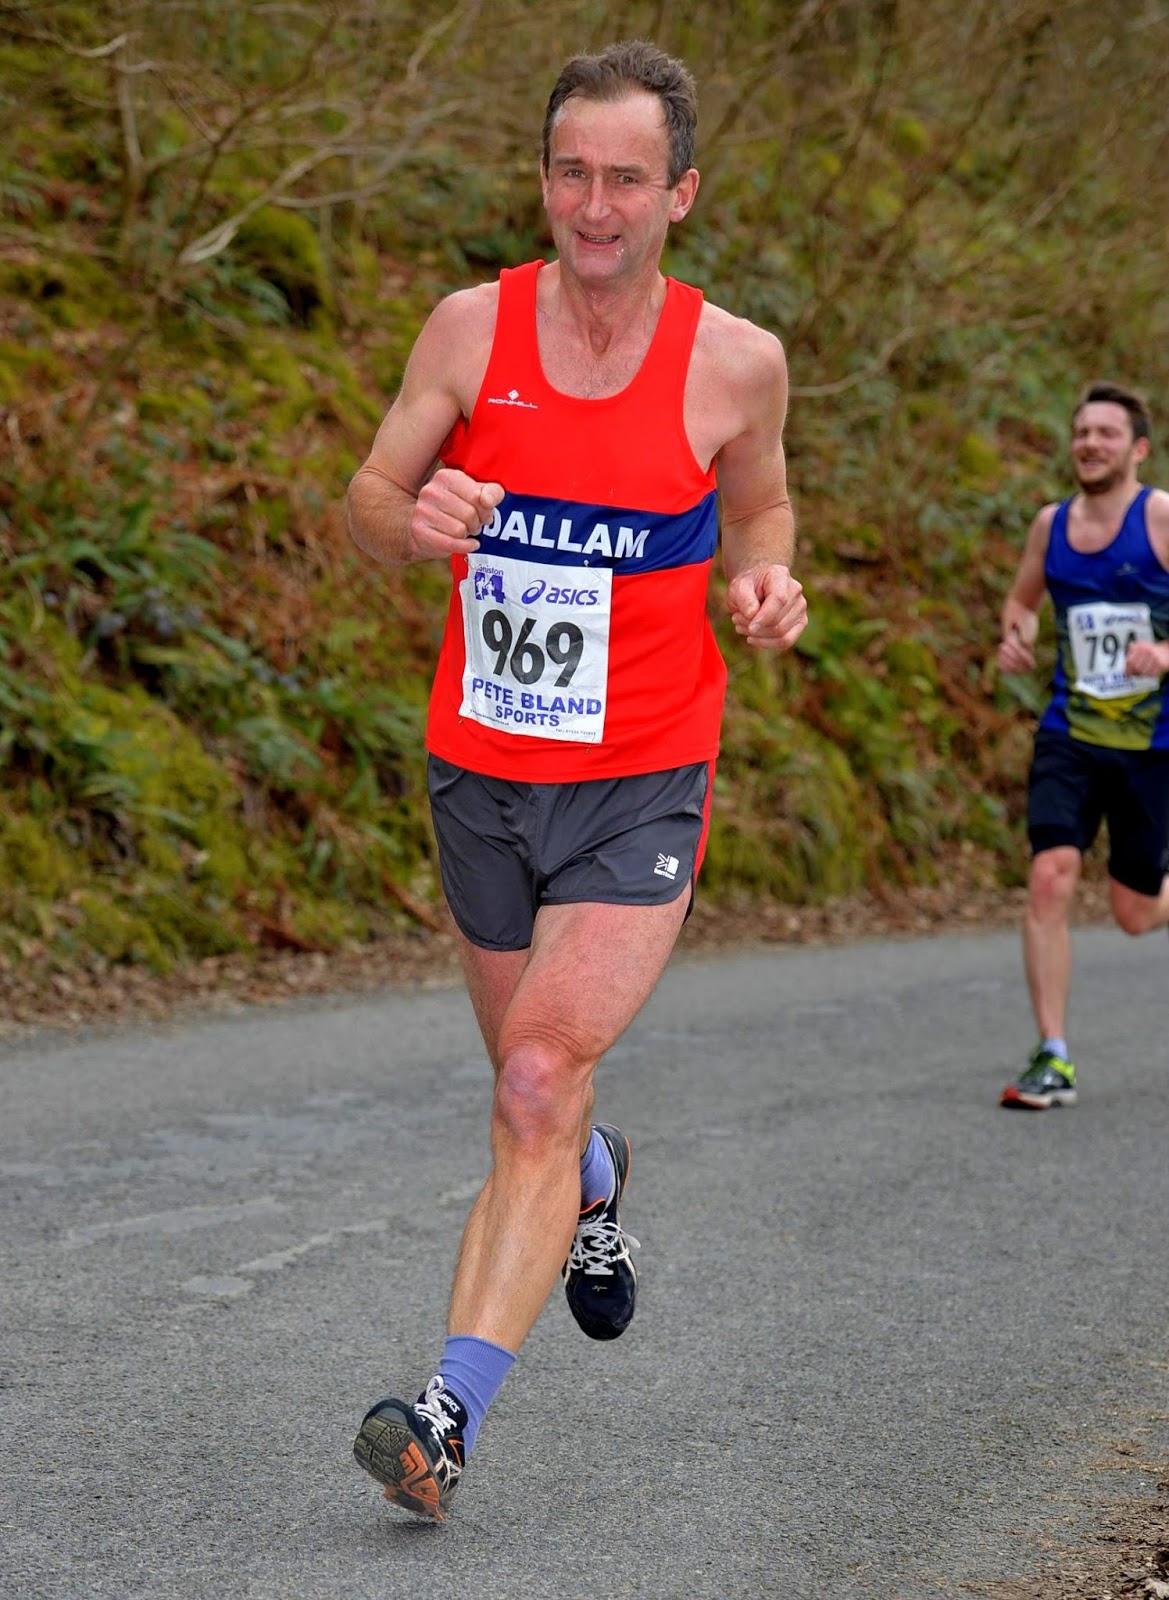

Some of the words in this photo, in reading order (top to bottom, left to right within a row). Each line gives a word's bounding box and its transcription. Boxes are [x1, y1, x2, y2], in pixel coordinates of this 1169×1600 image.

[482, 609, 584, 687] 969
[472, 677, 513, 706] PETE
[521, 692, 602, 715] BLAND
[495, 705, 560, 727] SPORTS
